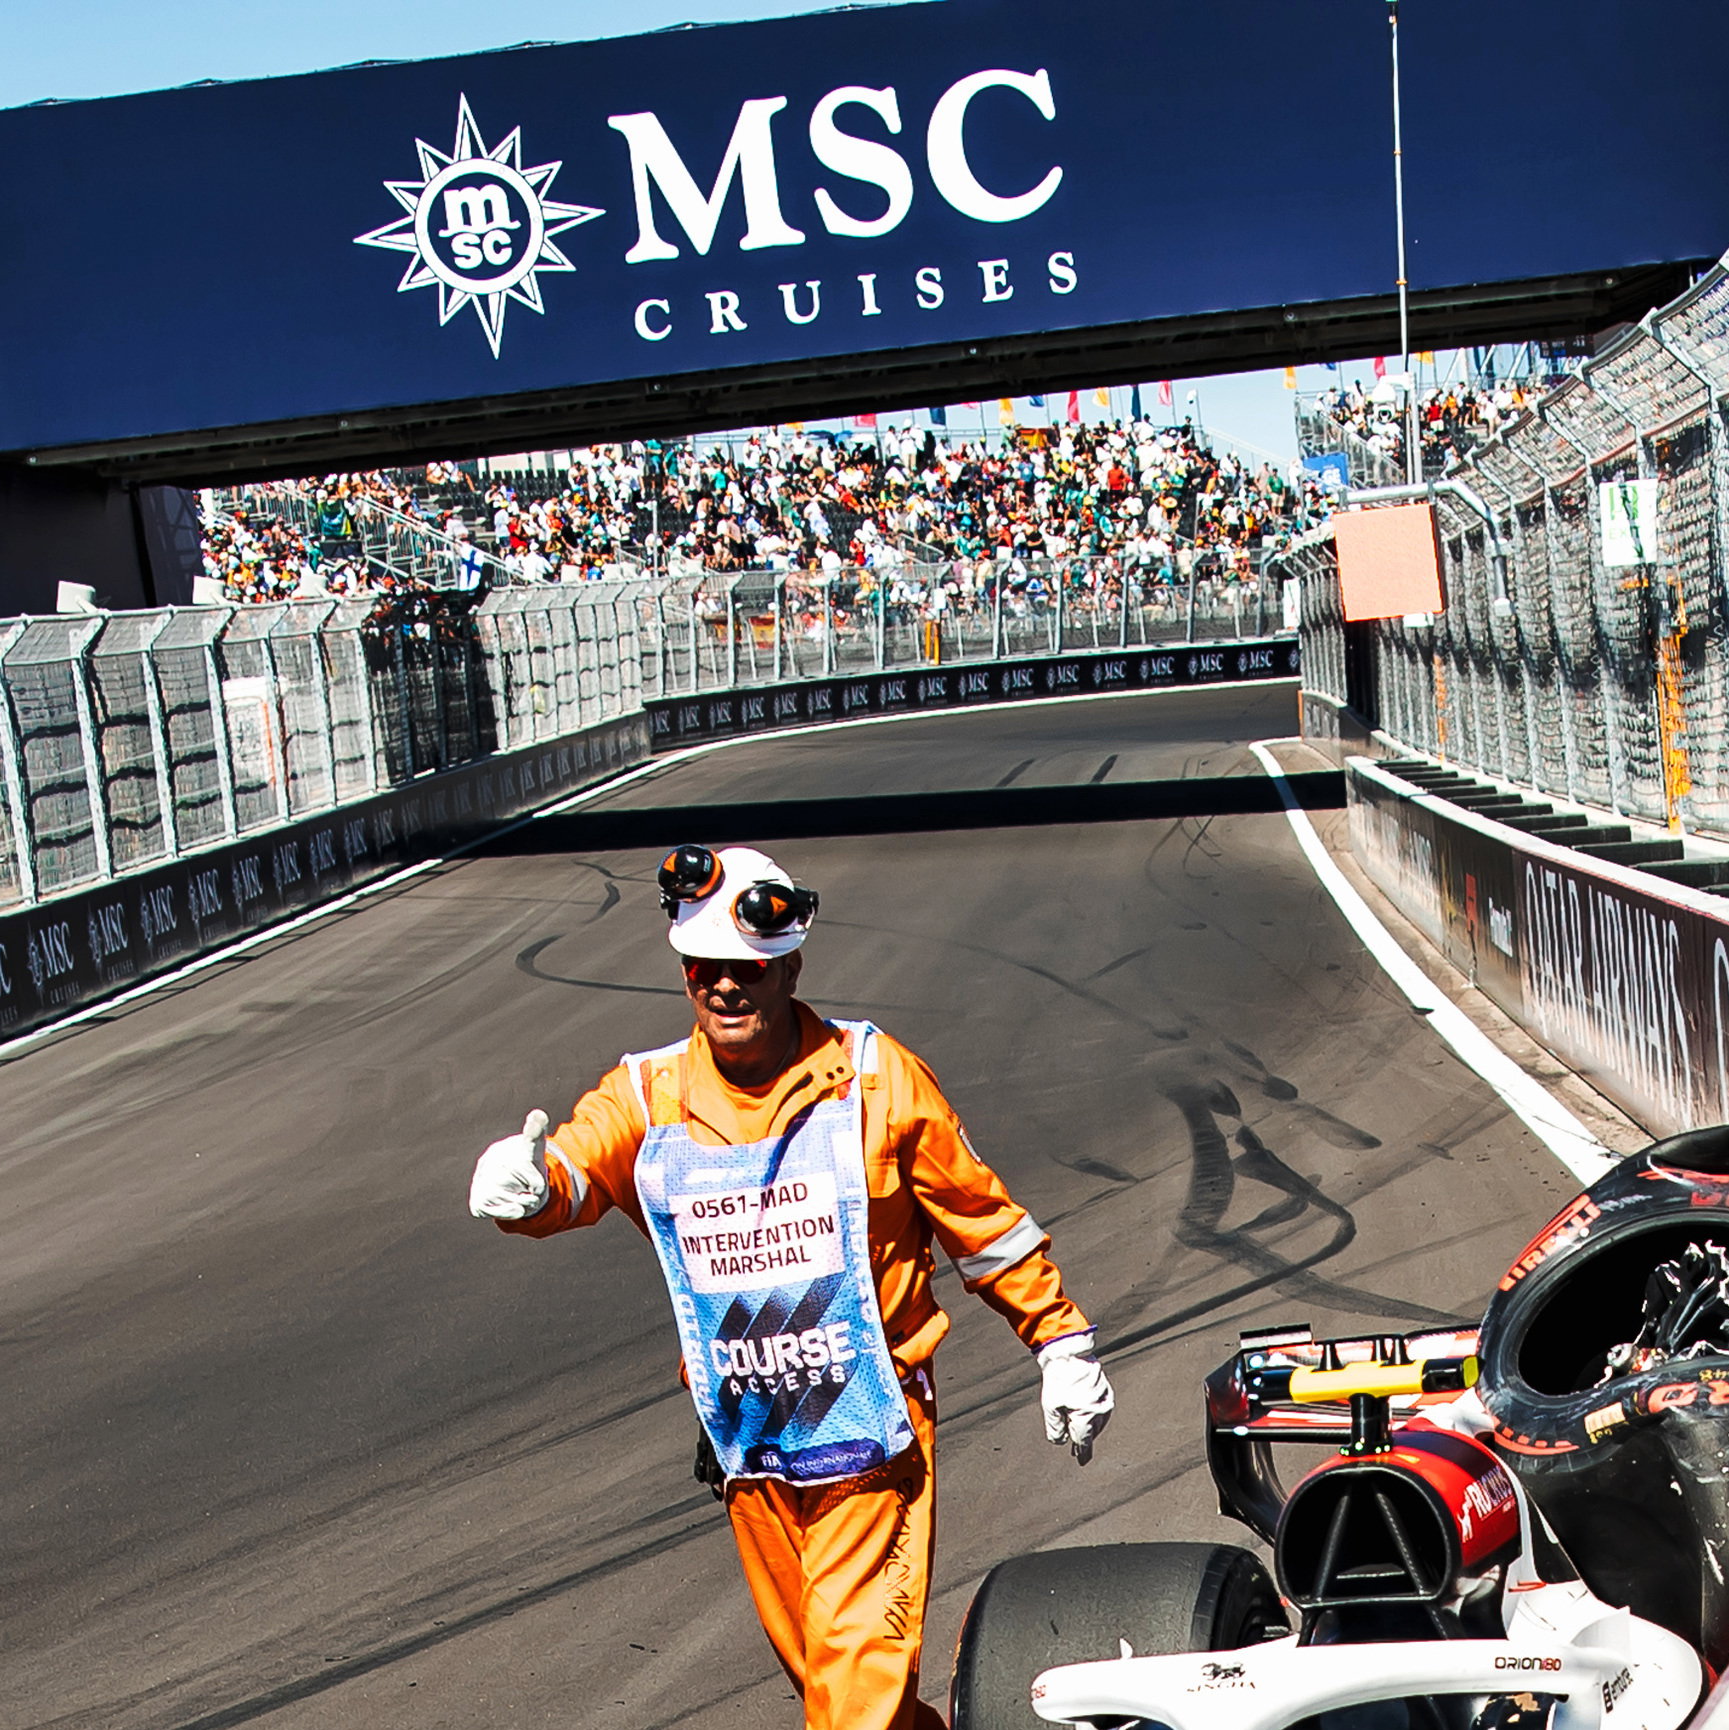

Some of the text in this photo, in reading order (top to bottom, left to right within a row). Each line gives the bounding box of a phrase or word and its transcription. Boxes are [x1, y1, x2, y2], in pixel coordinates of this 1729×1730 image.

[607, 68, 1064, 263] MSC
[634, 251, 1078, 342] CRUISES
[149, 885, 178, 935] MSC
[196, 868, 223, 916] MSC
[39, 921, 75, 978] MSC
[98, 902, 129, 955] MSC
[691, 1182, 809, 1220] 0561-MAD
[681, 1214, 835, 1255] INTERVENTION
[710, 1245, 812, 1277] MARSHAL
[708, 1320, 857, 1378] COURSE
[728, 1364, 847, 1397] ACCESS
[1494, 1656, 1562, 1672] ORION180
